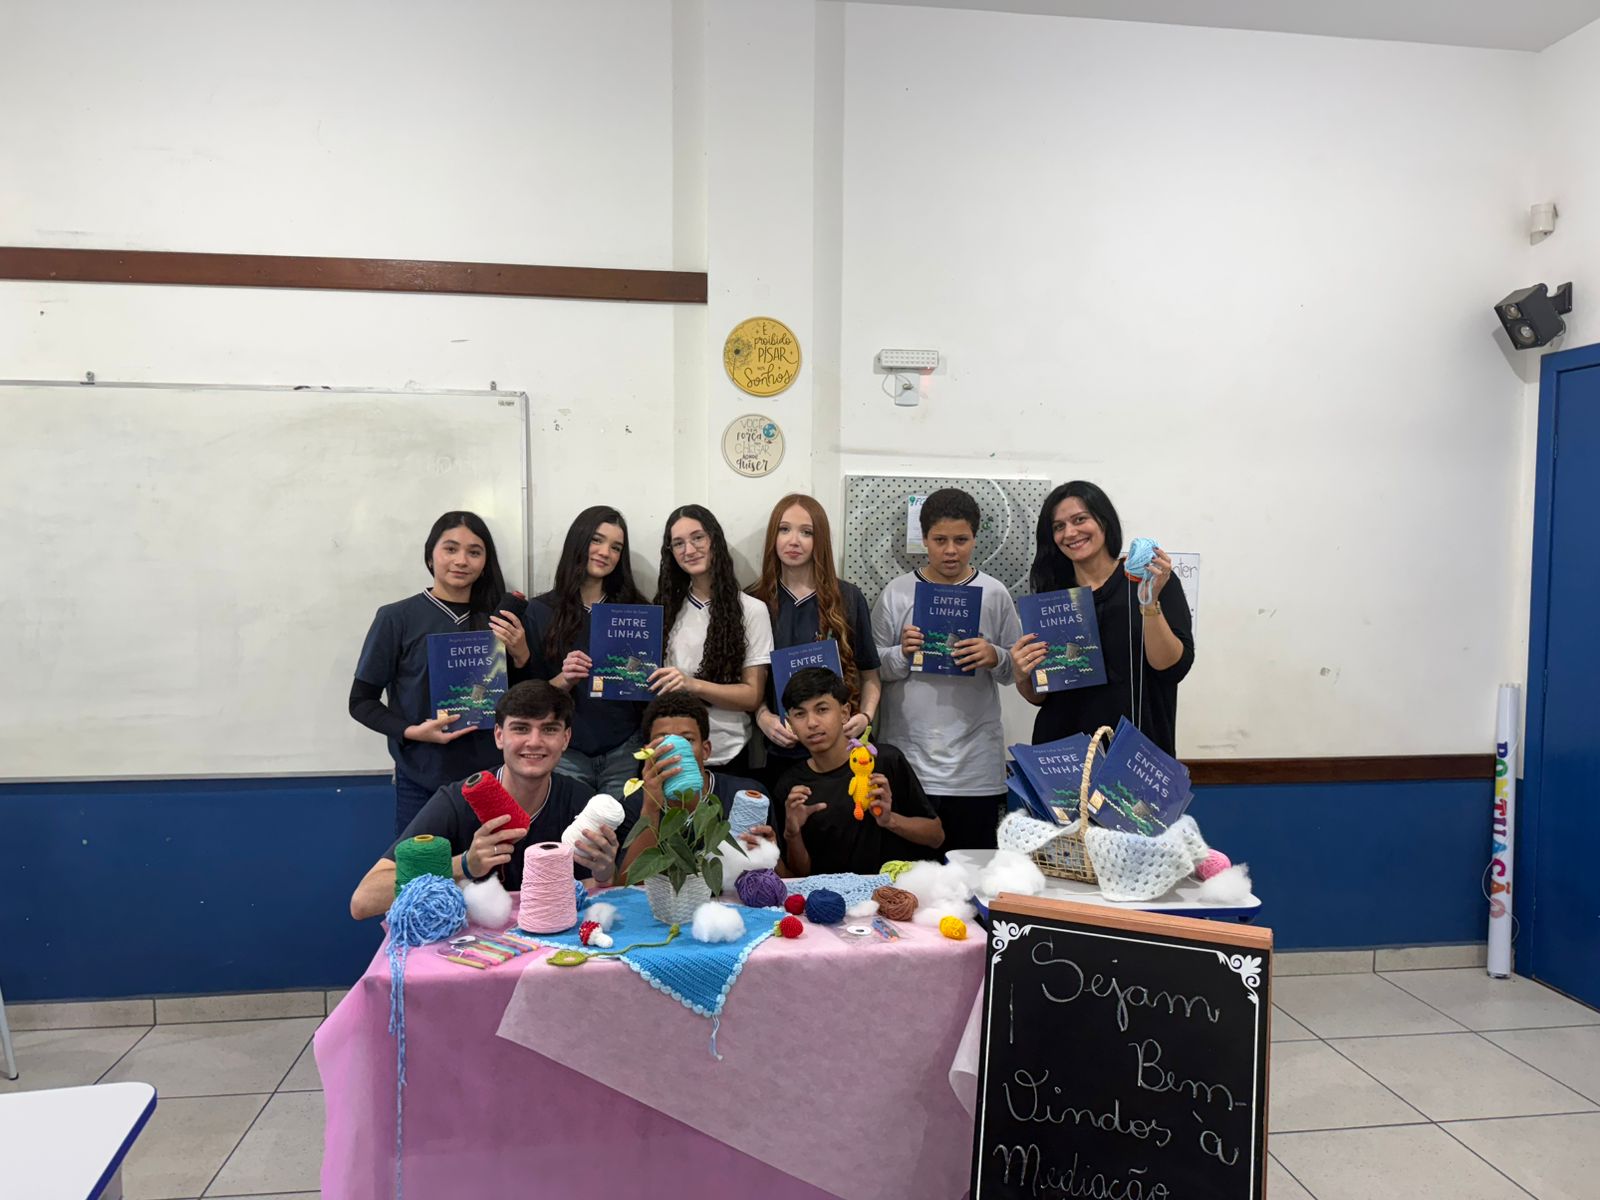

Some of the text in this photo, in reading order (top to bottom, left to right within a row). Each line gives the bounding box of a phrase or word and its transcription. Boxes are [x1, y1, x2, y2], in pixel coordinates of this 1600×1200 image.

[754, 333, 792, 350] proibido
[758, 346, 798, 364] PISAR
[744, 363, 793, 388] Sonhos
[933, 596, 967, 607] ENTRE
[929, 607, 969, 618] LINHAS
[1041, 602, 1078, 616] ENTRE
[611, 617, 647, 628] ENTRE
[1040, 613, 1083, 628] LINHAS
[607, 629, 650, 640] LINHAS
[450, 645, 489, 656] ENTRE
[447, 656, 493, 669] LINHAS
[790, 654, 824, 668] ENTRE
[1038, 753, 1080, 765] ENTRE
[1134, 751, 1171, 786] ENTRE
[1126, 758, 1169, 798] LINHAS
[1031, 936, 1220, 1032] Sejam
[1128, 1038, 1247, 1111] Bem-
[1002, 1069, 1239, 1166] Vindos à
